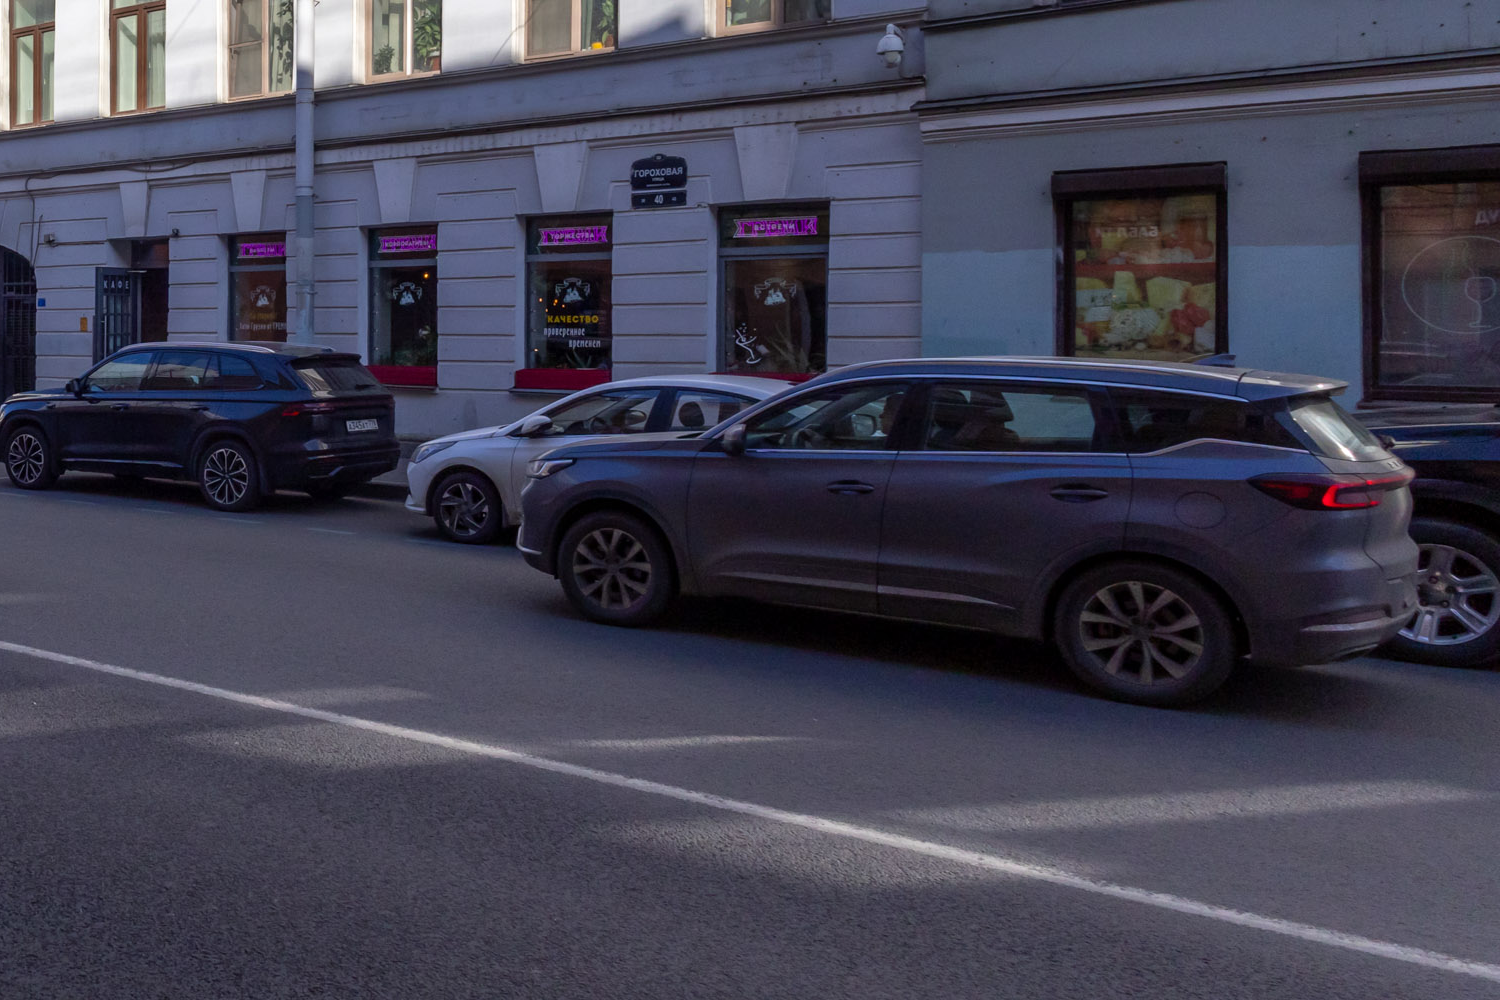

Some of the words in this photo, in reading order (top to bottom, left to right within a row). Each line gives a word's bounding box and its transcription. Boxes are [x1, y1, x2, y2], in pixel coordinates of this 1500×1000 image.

[634, 167, 683, 178] ГОРОХОВАЯ
[654, 194, 664, 204] 40
[103, 280, 129, 289] КАФЕ
[547, 315, 599, 324] КАЧЕСТВО
[543, 327, 585, 338] проверенное
[569, 339, 601, 349] временем
